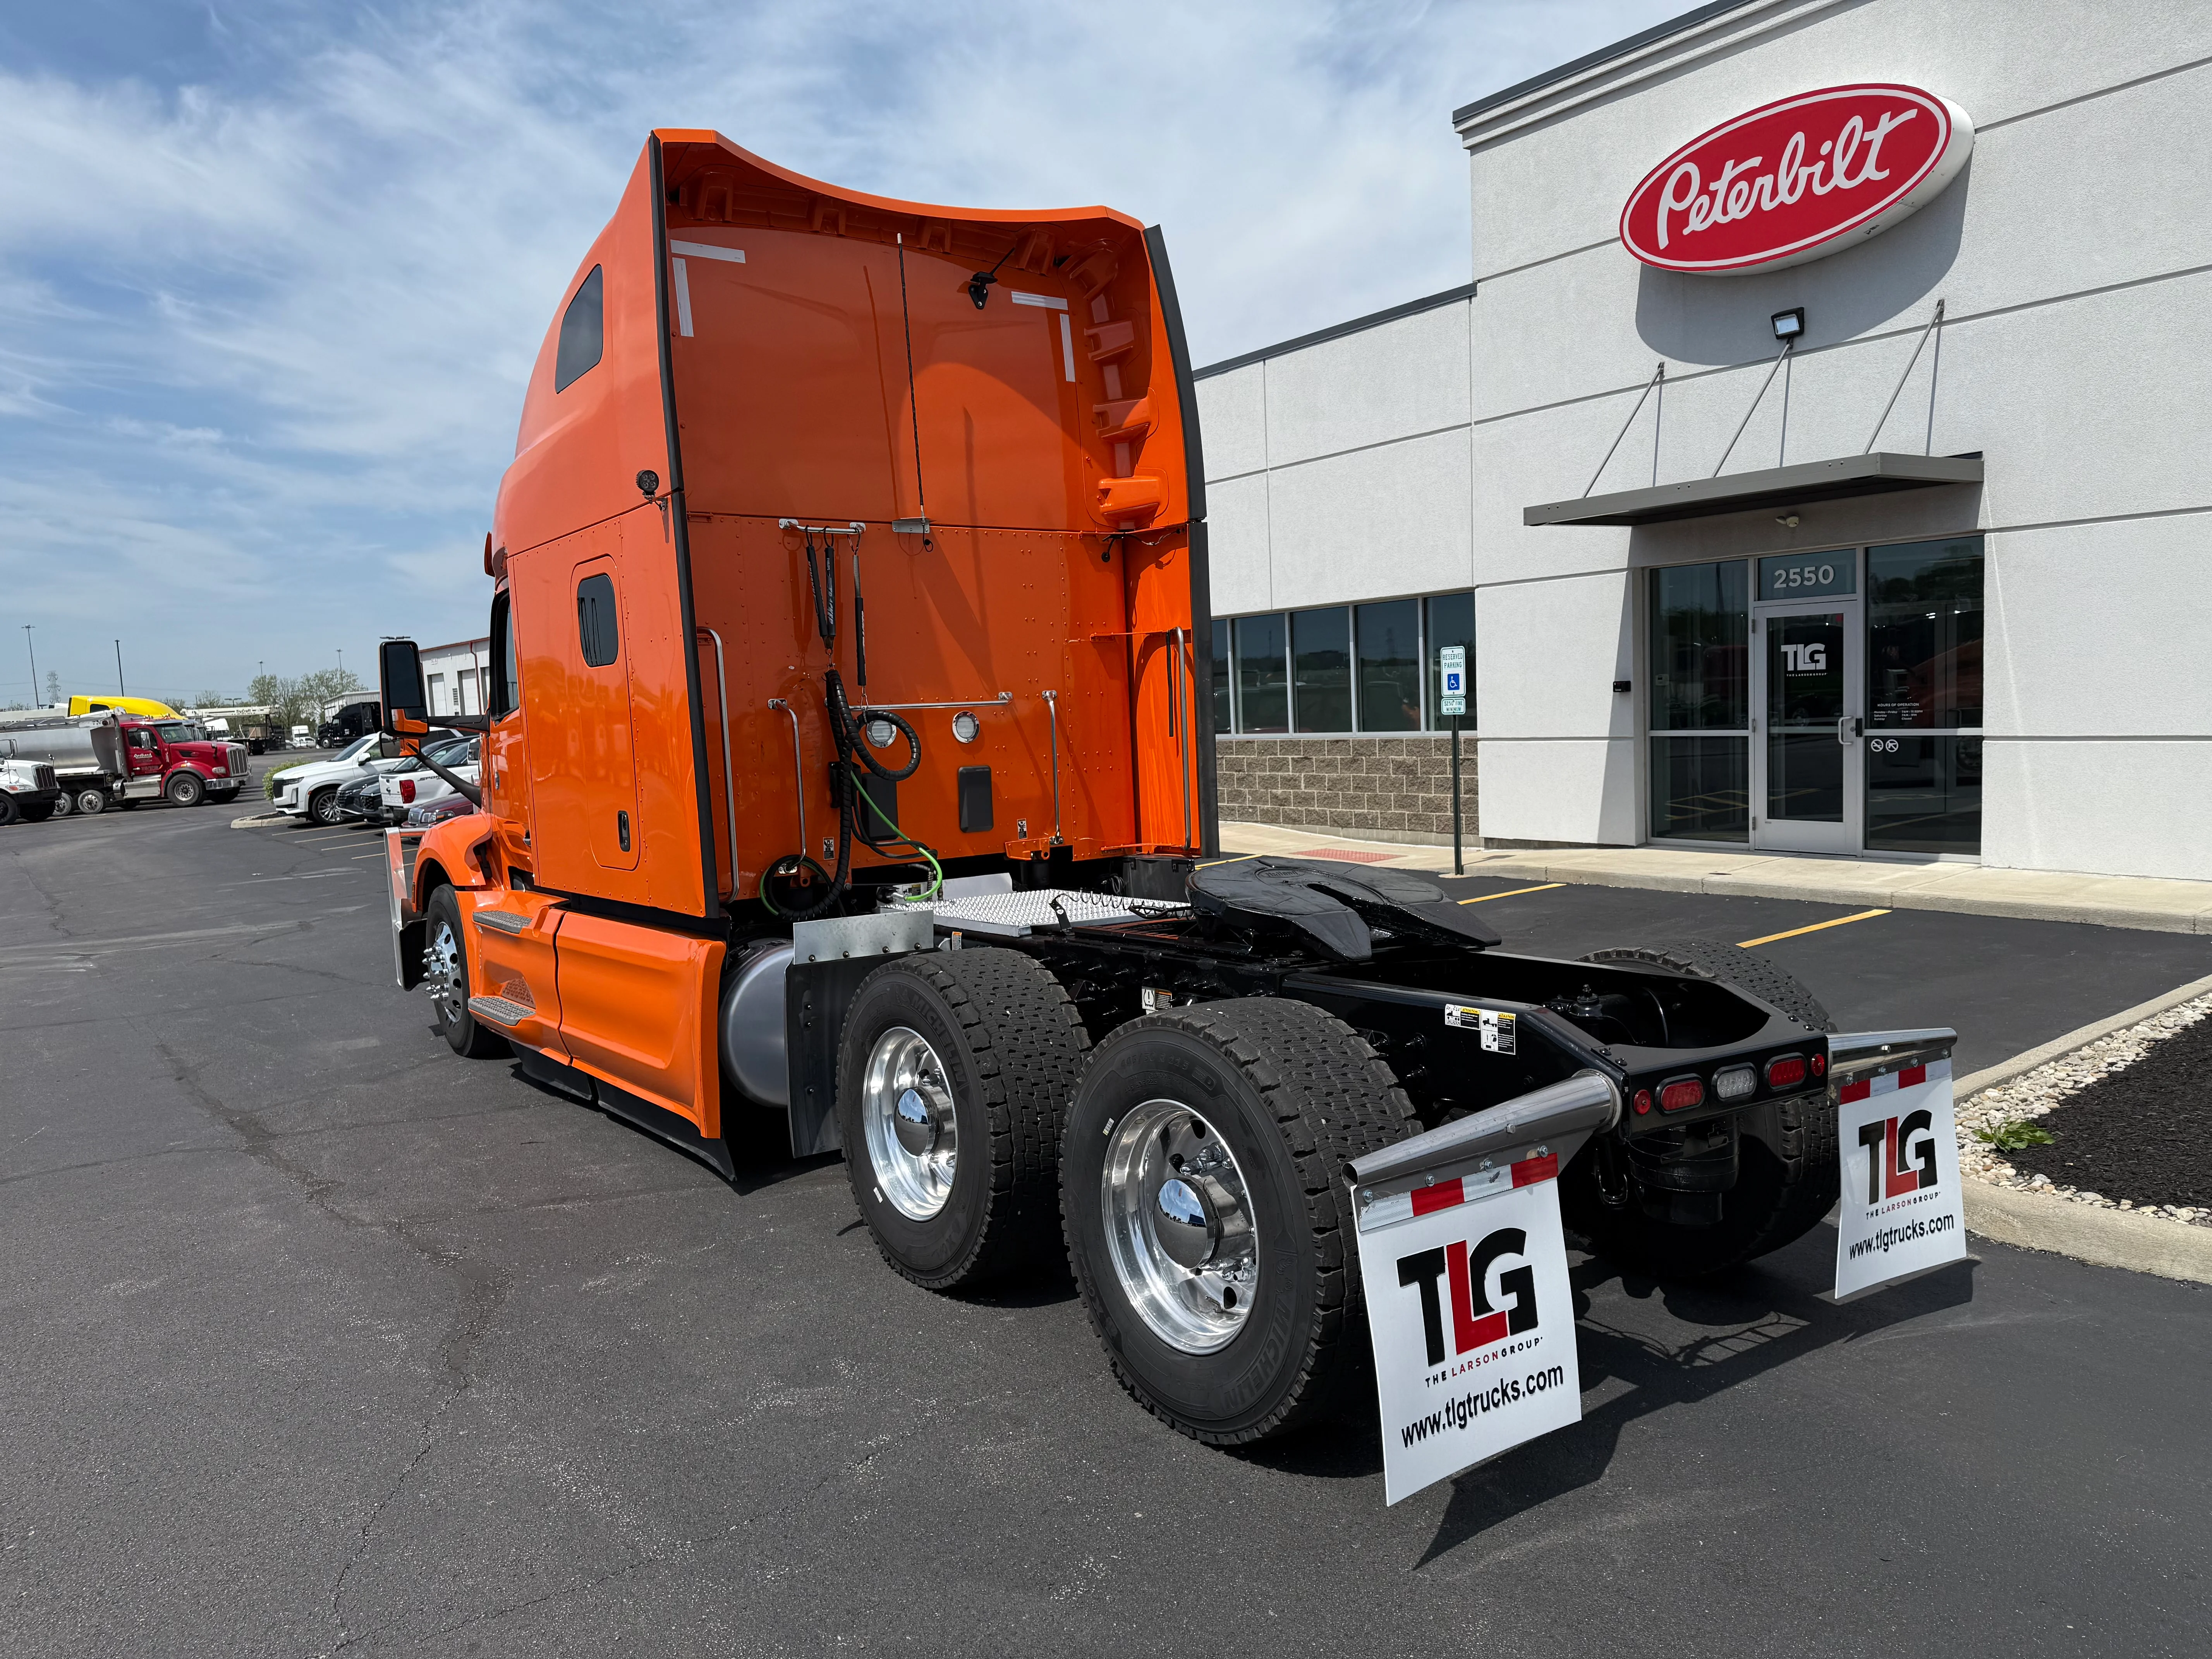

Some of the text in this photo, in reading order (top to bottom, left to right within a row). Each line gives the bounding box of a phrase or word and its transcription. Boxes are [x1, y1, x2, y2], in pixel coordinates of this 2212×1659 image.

[1657, 109, 1918, 249] Peterbilt
[1774, 565, 1834, 589] 2550
[1781, 643, 1826, 671] TLG
[911, 994, 966, 1082] MICHELIN
[1859, 1109, 1937, 1205] TLG
[1849, 1214, 1954, 1260] www.tlgtrucks.com
[1866, 1209, 1879, 1219] THE
[1396, 1227, 1538, 1367] TLG
[1224, 1298, 1291, 1410] MICHELIN
[1425, 1370, 1447, 1388] THE
[1401, 1364, 1563, 1449] www.tlgtrucks.com
